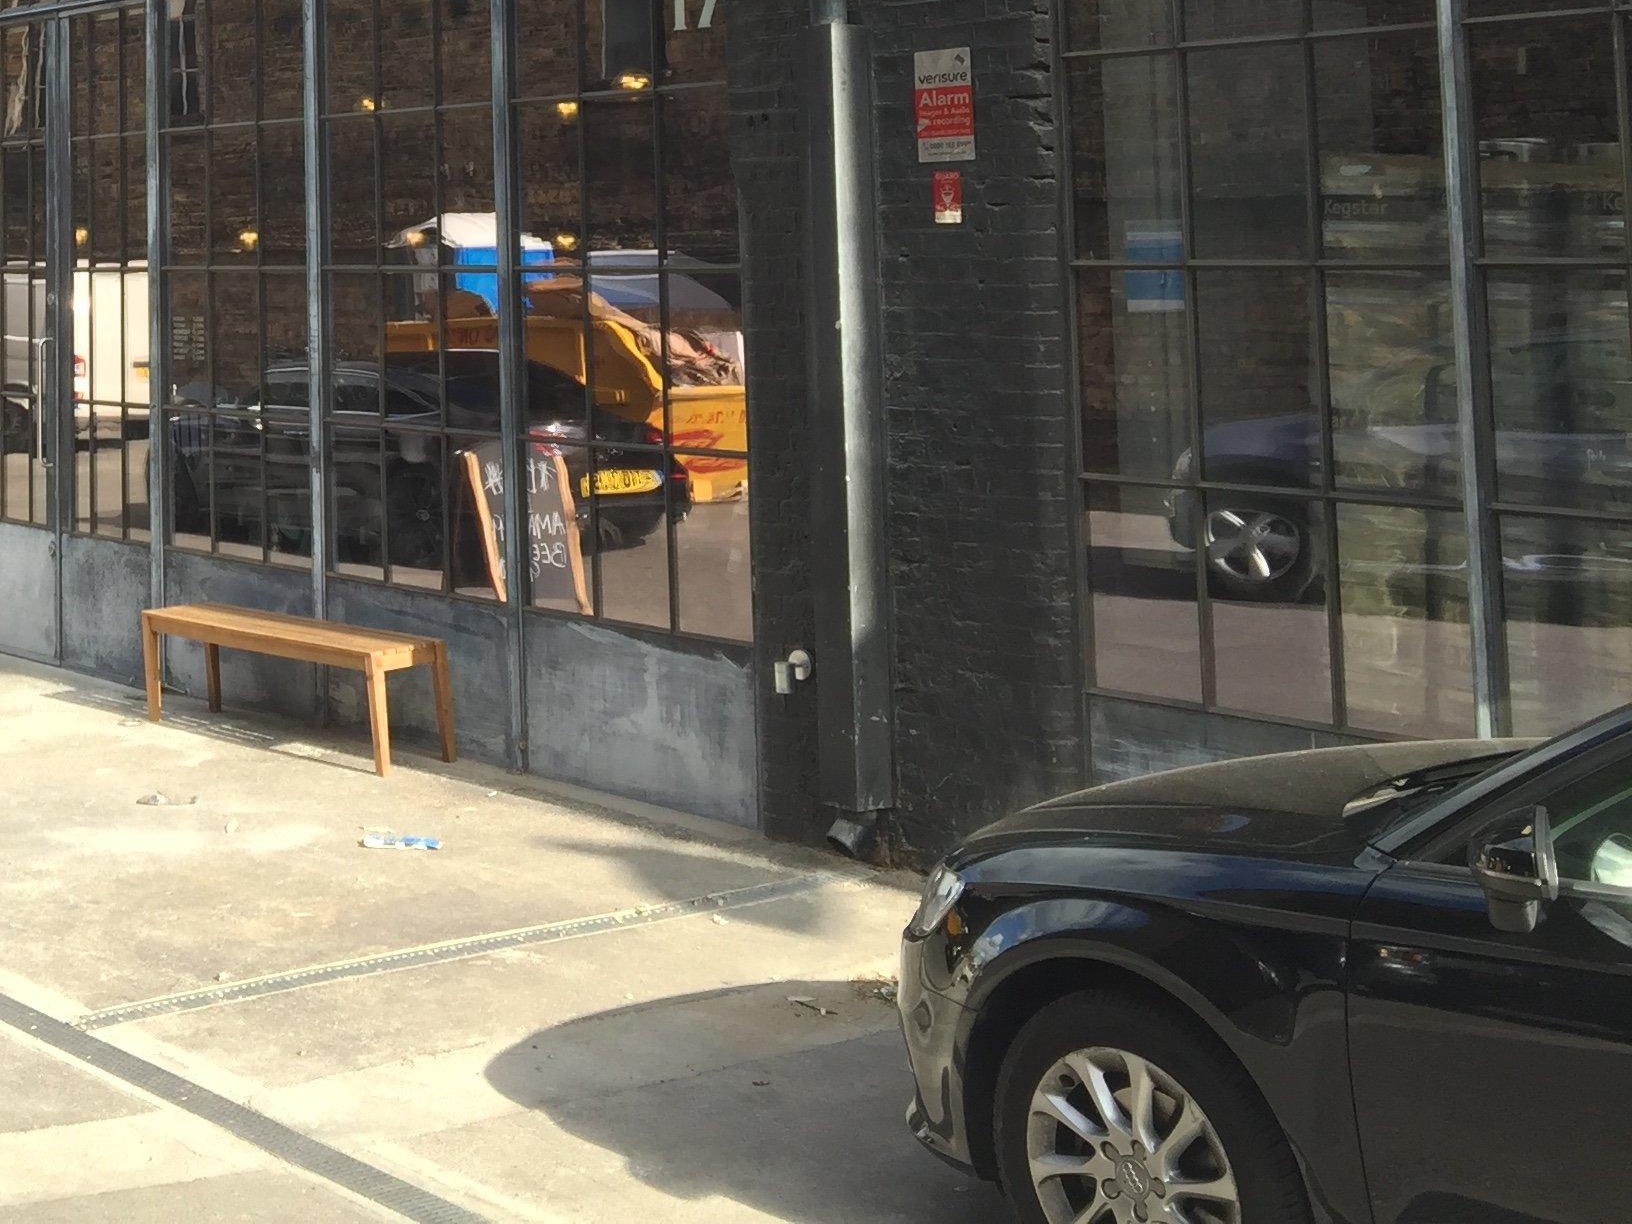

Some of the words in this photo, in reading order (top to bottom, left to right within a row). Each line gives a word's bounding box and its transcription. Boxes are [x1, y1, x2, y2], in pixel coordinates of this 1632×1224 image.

[918, 70, 968, 85] verisure
[919, 90, 969, 107] Alarm
[933, 115, 970, 126] recording
